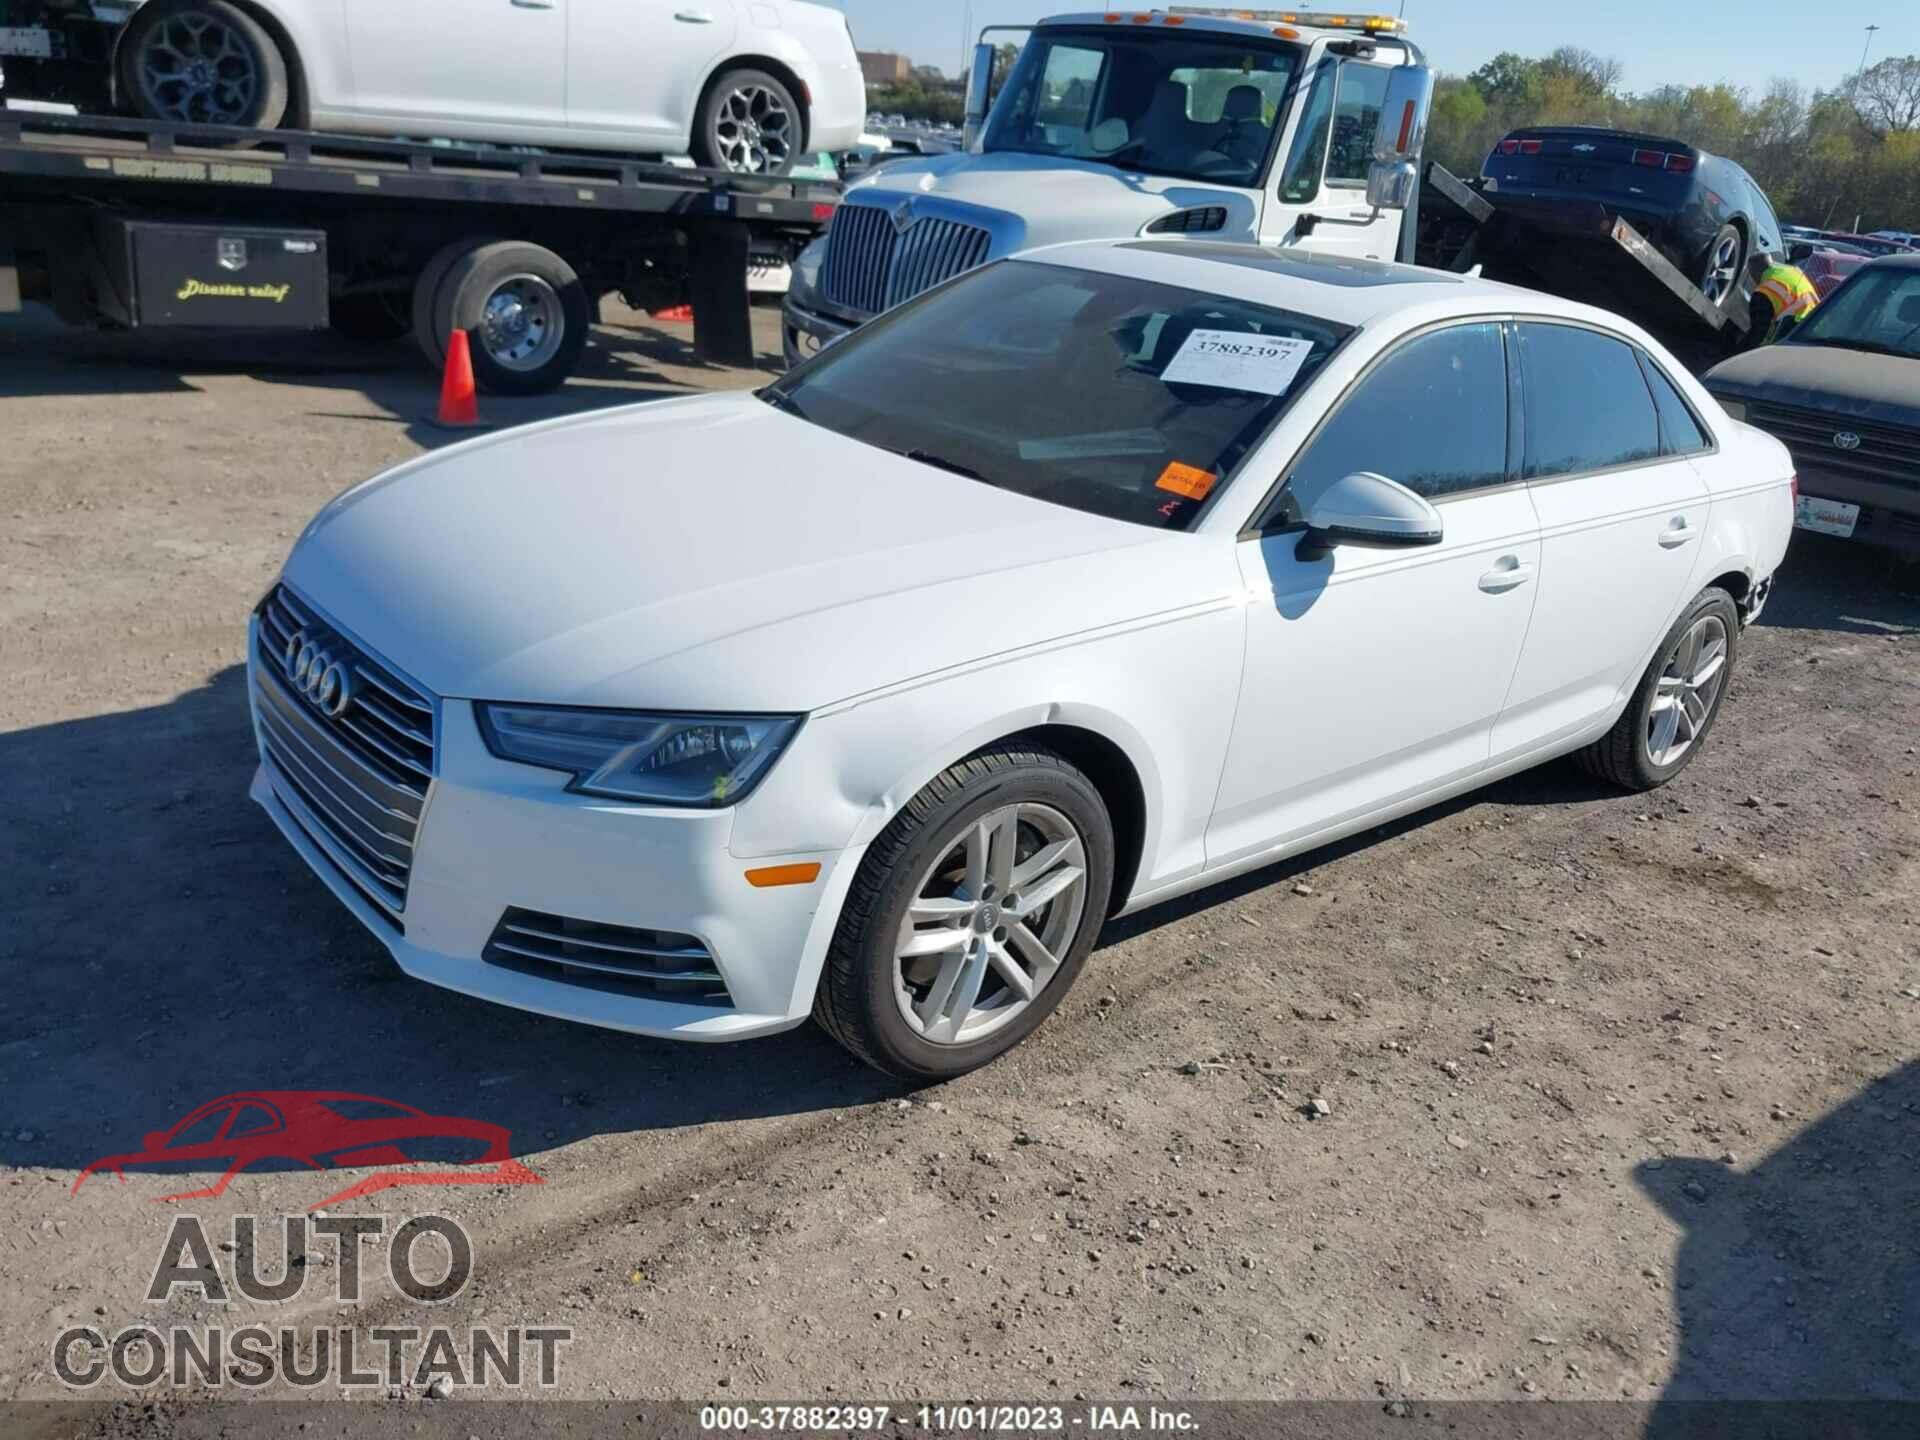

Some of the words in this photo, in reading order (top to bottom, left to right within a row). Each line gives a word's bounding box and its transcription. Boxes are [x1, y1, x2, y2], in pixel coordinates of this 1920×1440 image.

[177, 279, 246, 300] Disaster
[248, 283, 290, 303] relief
[1193, 341, 1291, 360] 37882397
